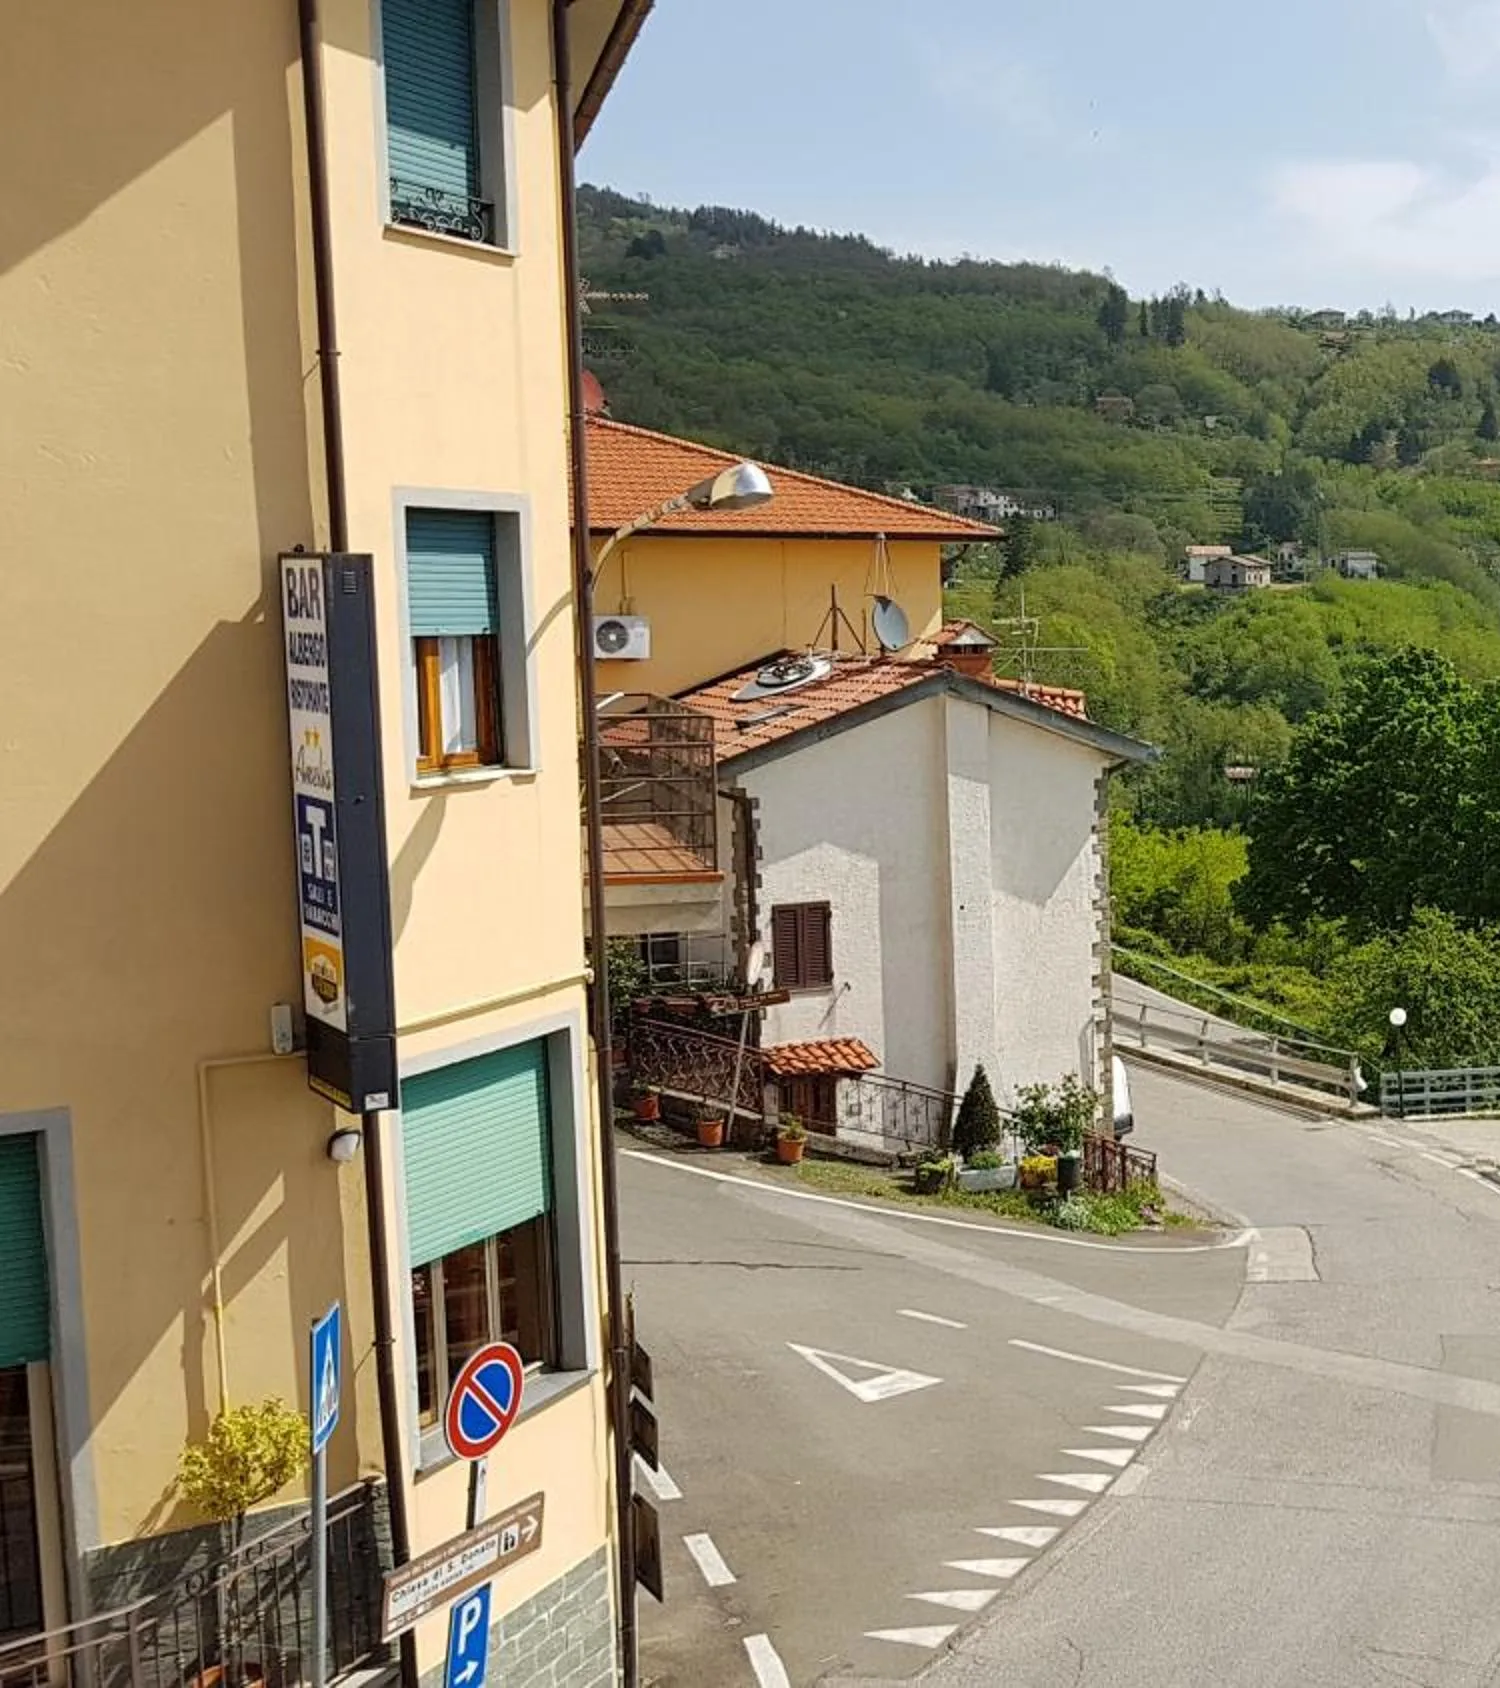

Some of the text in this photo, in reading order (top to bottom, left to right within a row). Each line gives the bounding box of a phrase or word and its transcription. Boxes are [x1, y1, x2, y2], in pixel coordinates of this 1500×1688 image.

[286, 567, 321, 620] BAR
[289, 630, 325, 669] ALBERGO
[391, 1577, 429, 1603] Chiesa
[433, 1566, 443, 1581] di
[461, 1539, 496, 1564] Donato
[458, 1596, 482, 1656] P
